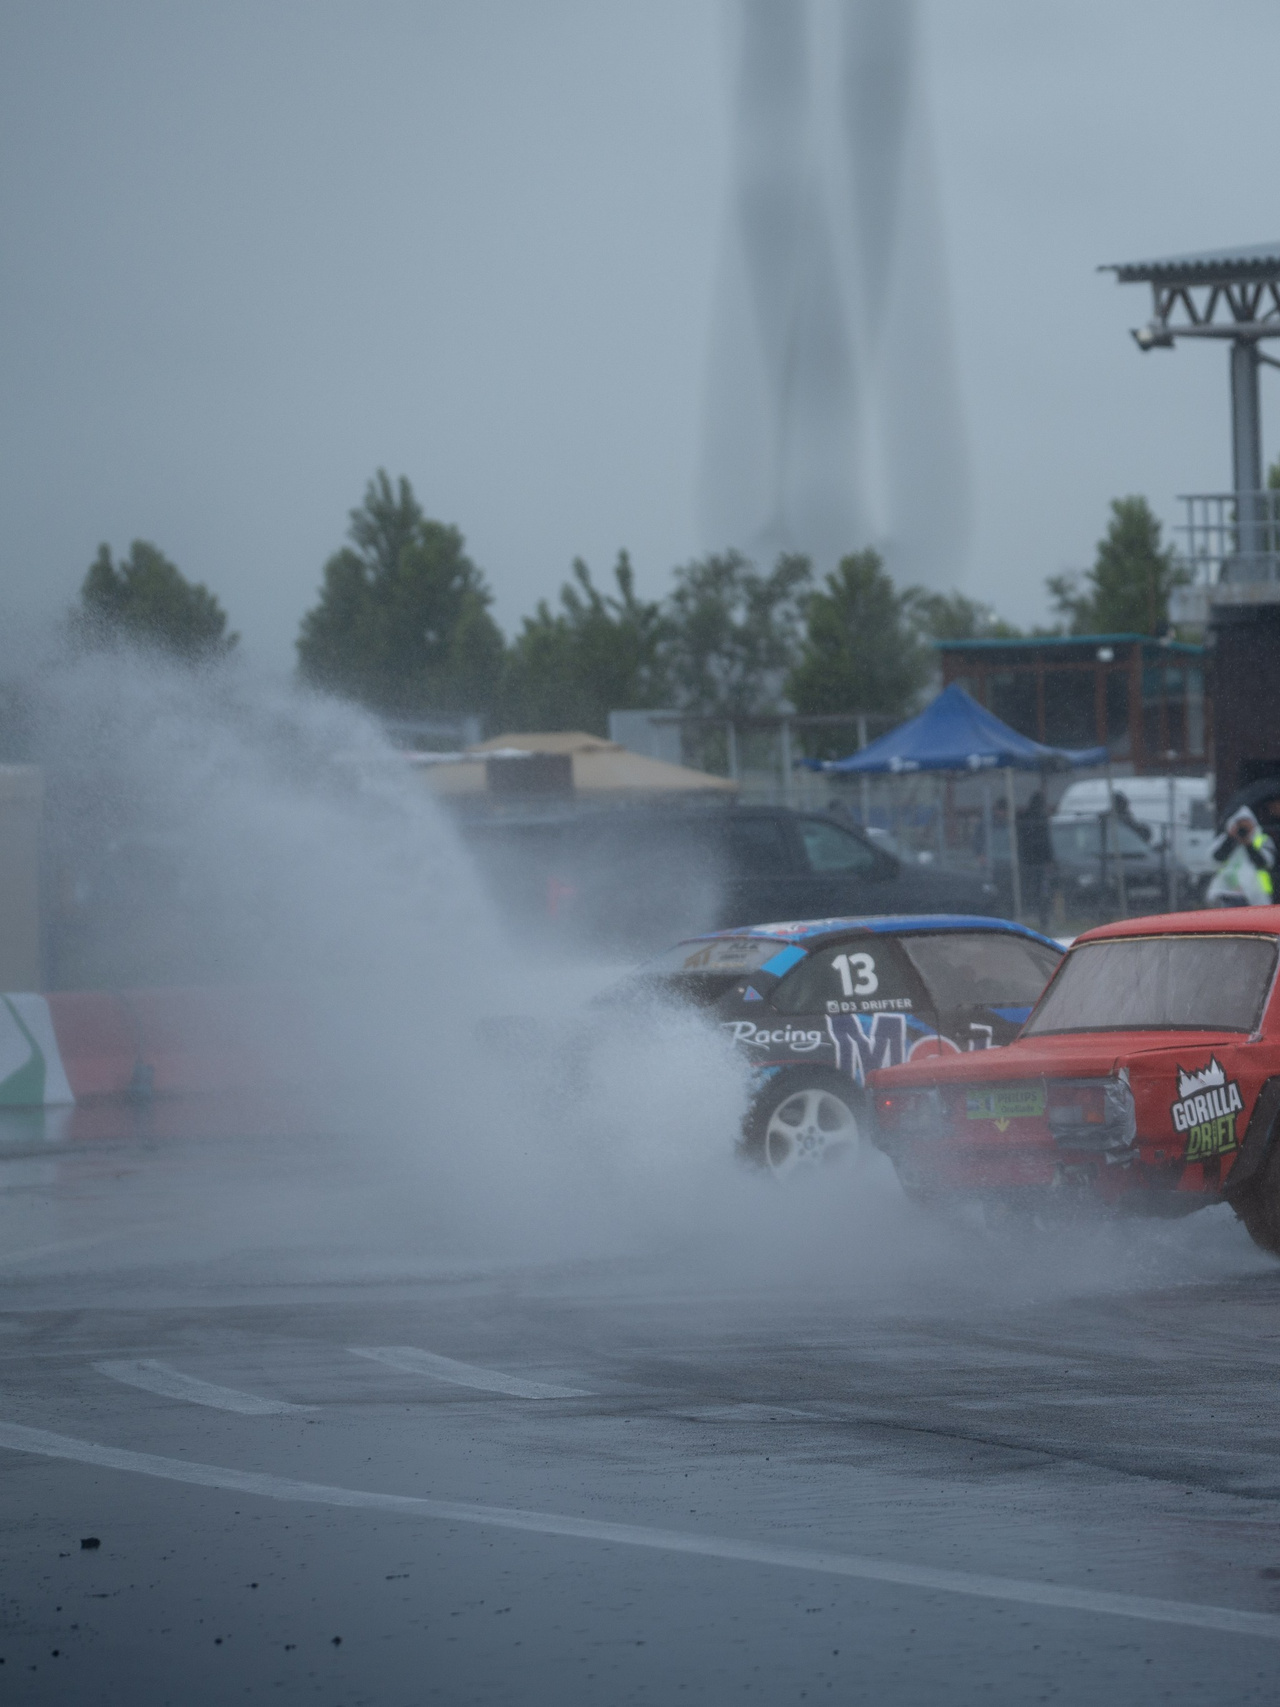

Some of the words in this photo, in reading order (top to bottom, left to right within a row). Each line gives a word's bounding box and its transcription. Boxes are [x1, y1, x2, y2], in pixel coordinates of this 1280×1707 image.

[831, 952, 879, 997] 13
[721, 1021, 832, 1052] Racing
[1172, 1083, 1243, 1131] GORILLA
[1188, 1113, 1236, 1153] DRIFT
